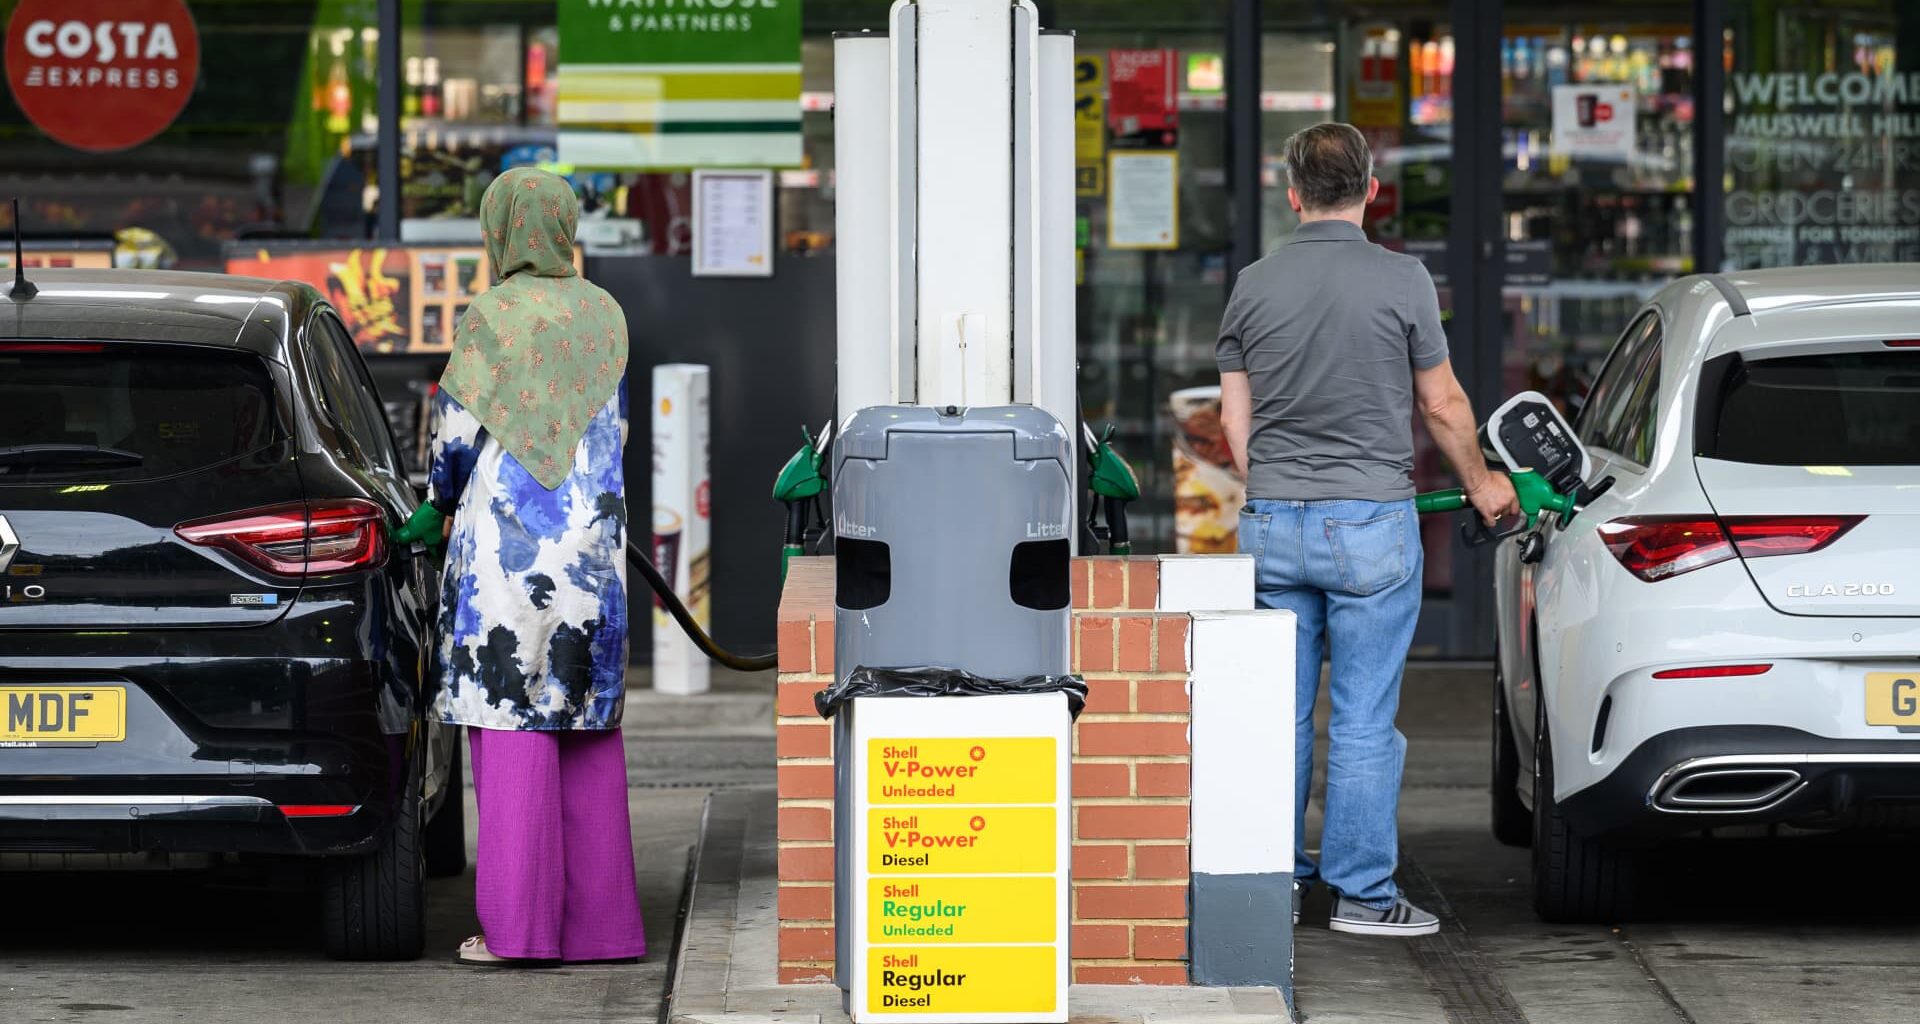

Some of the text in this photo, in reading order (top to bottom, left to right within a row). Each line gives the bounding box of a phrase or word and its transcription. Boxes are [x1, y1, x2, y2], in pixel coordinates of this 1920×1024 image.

[609, 14, 752, 32] & PARTNERS
[24, 20, 179, 64] COSTA
[48, 66, 179, 88] EXPRESS
[1736, 113, 1865, 137] MUSWELL
[1733, 142, 1825, 172] OPEN
[1725, 190, 1920, 225] GROCERIES
[1800, 226, 1835, 243] FOR
[1026, 521, 1068, 537] Litter
[1787, 583, 1895, 597] CLA 200
[1892, 678, 1917, 717] G
[8, 692, 94, 732] MDF
[882, 746, 918, 759] Shell
[884, 761, 978, 778] V-Power
[882, 784, 955, 797] Unleaded
[882, 816, 918, 829] Shell
[884, 831, 978, 848] V-Power
[882, 853, 929, 866] Diesel
[883, 884, 919, 898] Shell
[883, 900, 966, 921] Regular
[883, 924, 954, 936] Unleaded
[882, 954, 918, 968] Shell
[882, 969, 966, 991] Regular
[882, 994, 931, 1007] Diesel
